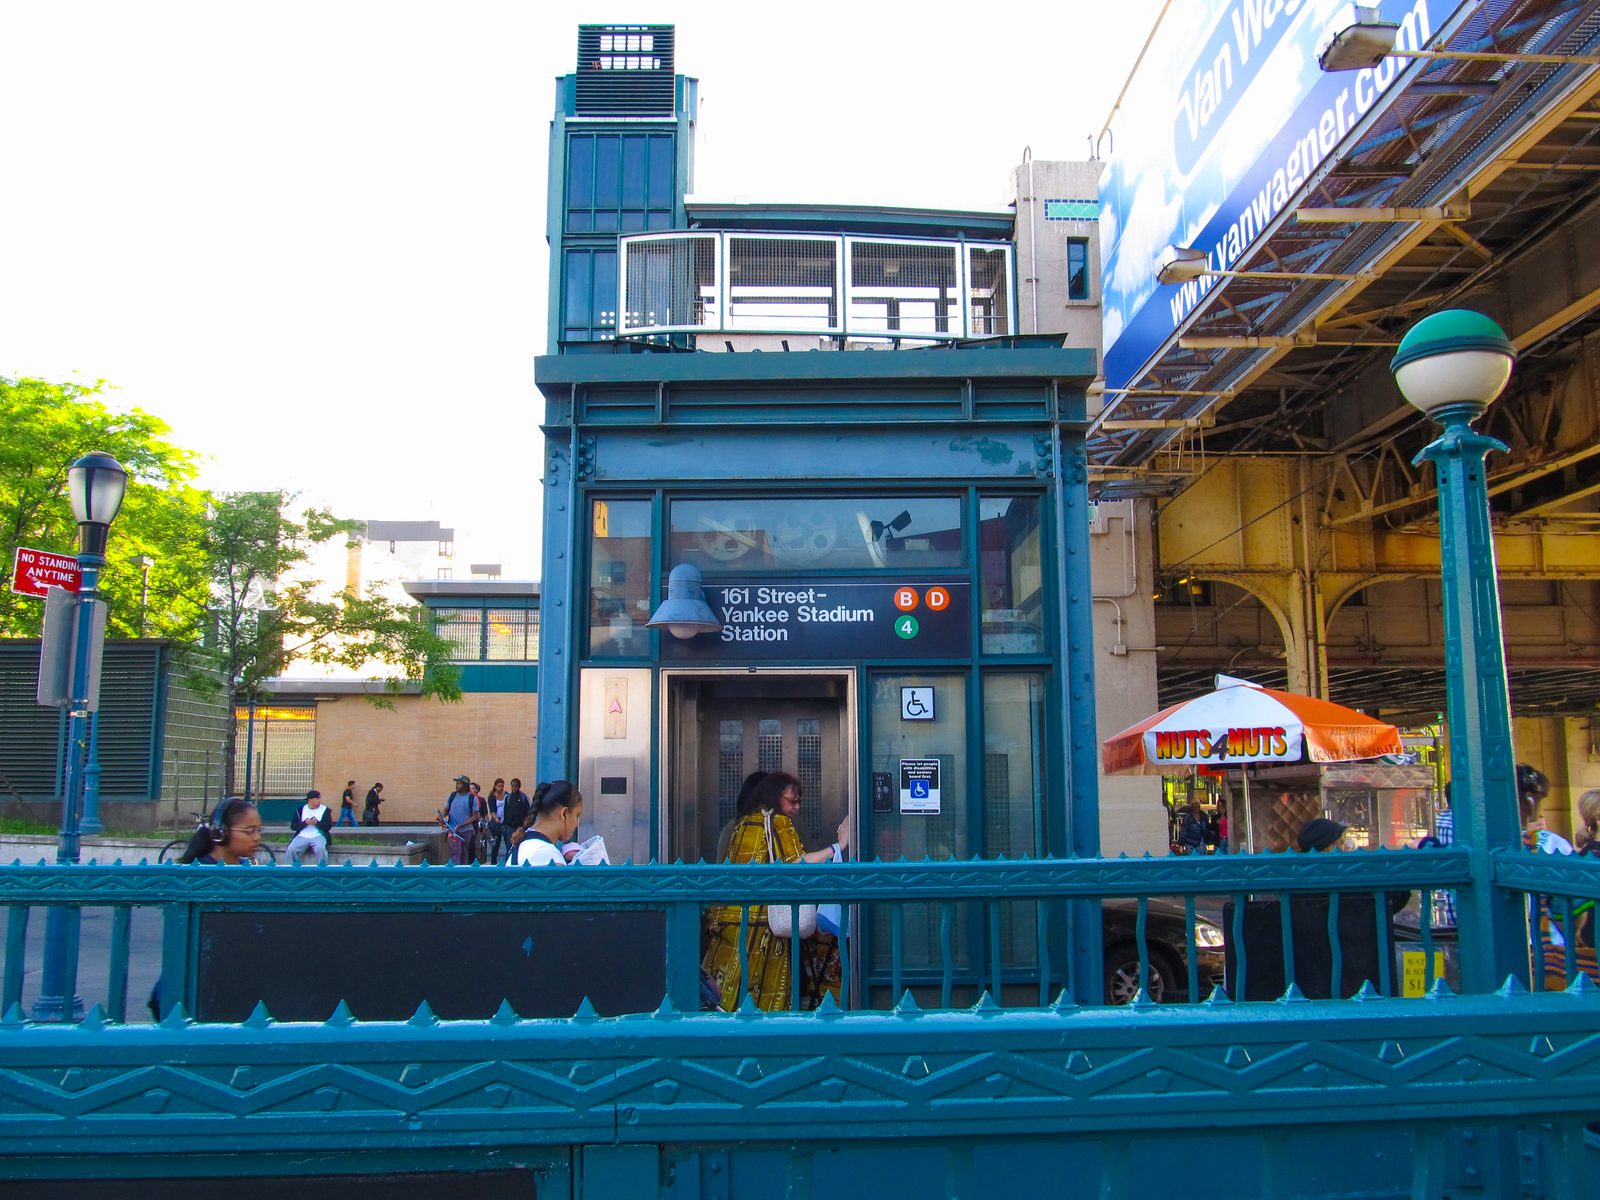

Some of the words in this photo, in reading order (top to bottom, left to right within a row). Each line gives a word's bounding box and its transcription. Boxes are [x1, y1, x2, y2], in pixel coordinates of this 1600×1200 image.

[1182, 42, 1232, 143] Van
[21, 553, 35, 563] NO
[27, 567, 75, 583] ANYTIME
[720, 588, 749, 604] 161
[757, 588, 827, 605] Street-
[900, 592, 912, 606] B
[931, 592, 944, 606] D
[721, 606, 789, 623] Yankee
[797, 605, 874, 622] Stadium
[720, 625, 788, 642] Station
[901, 620, 912, 634] 4
